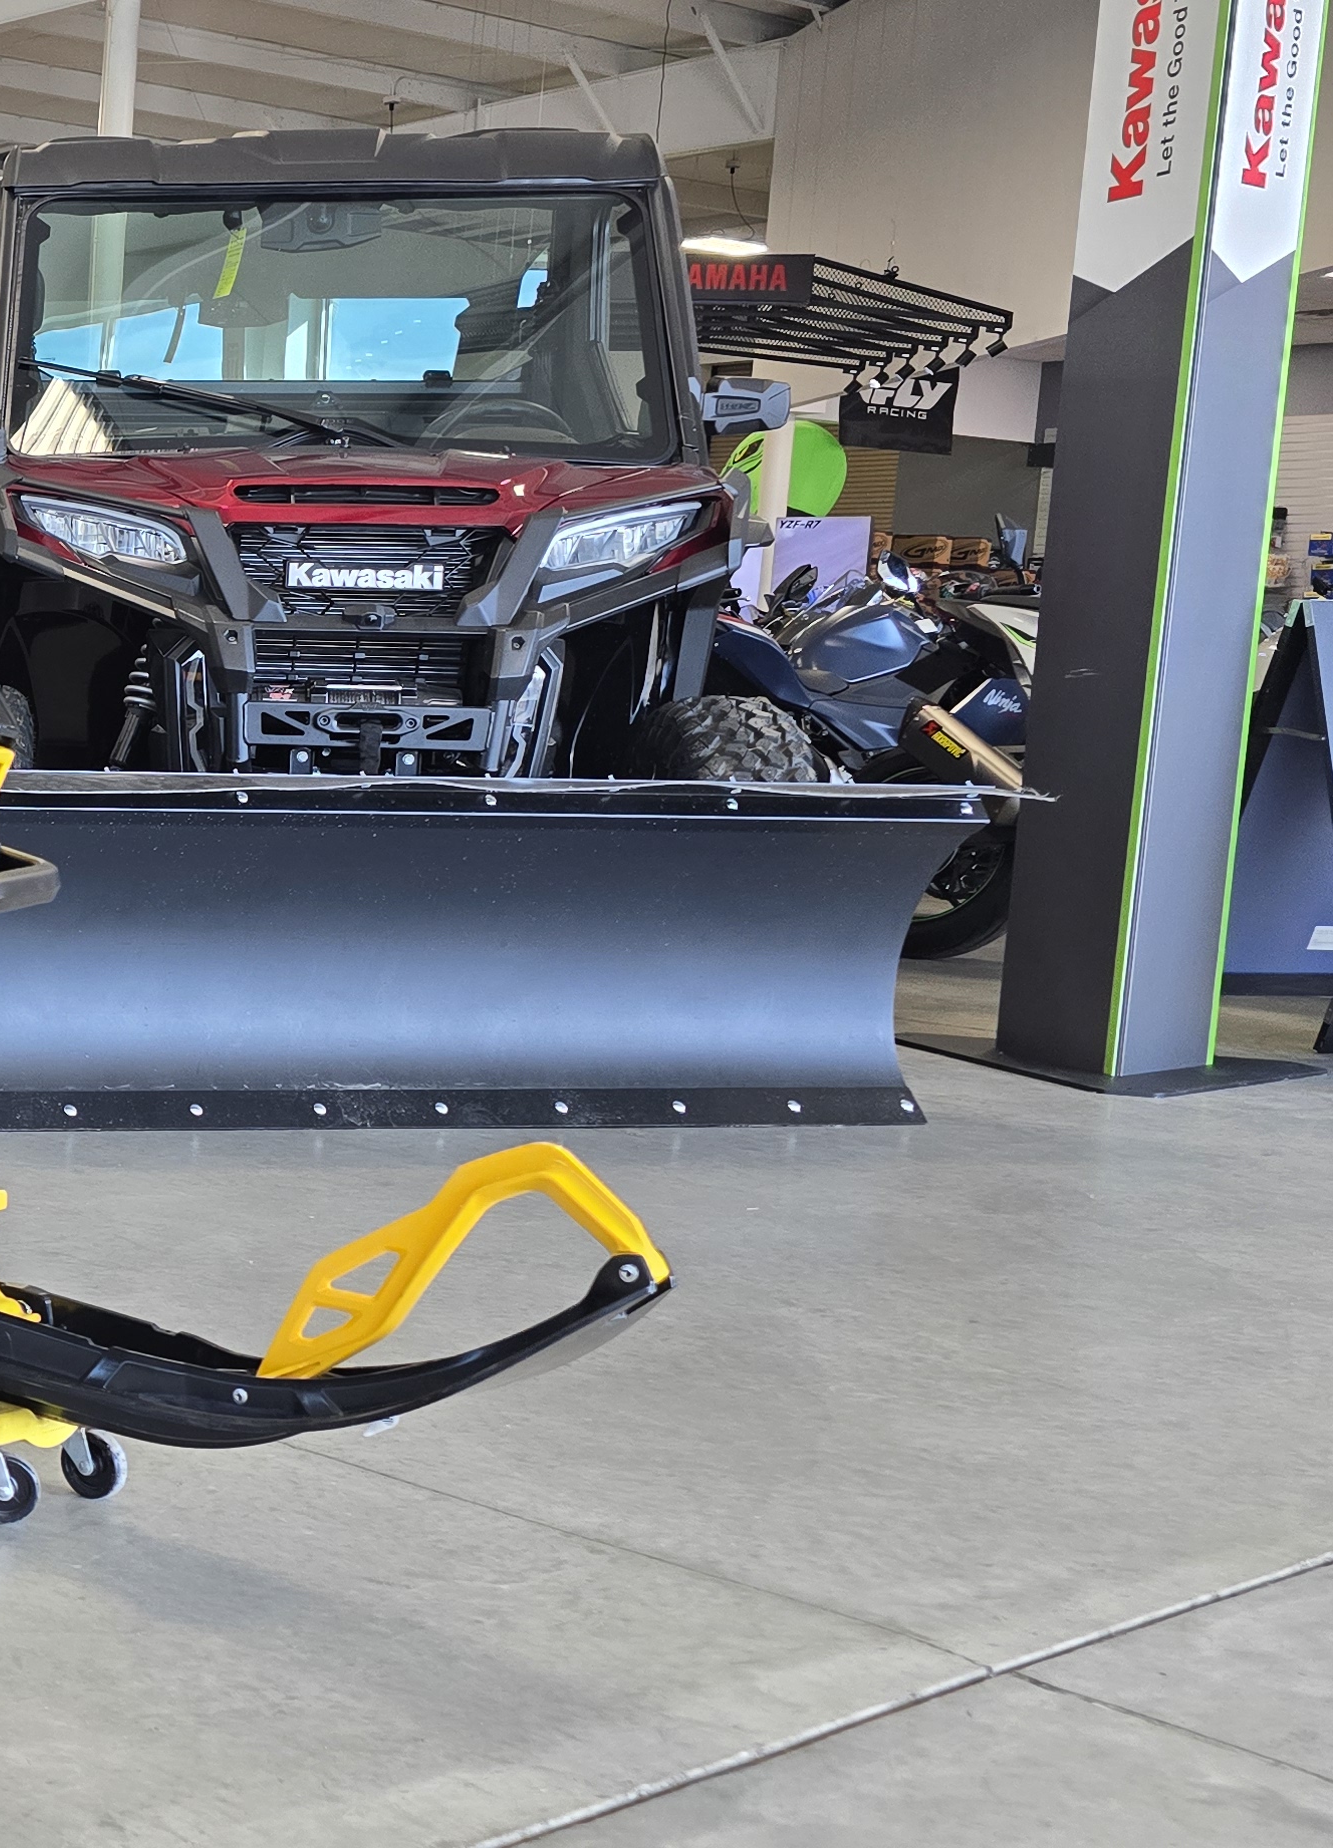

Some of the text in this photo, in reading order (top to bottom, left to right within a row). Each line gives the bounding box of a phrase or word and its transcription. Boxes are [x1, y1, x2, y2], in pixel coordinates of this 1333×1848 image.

[1107, 0, 1161, 203] Kawa
[1156, 6, 1188, 177] Let the Good
[1275, 8, 1303, 178] Let the Good
[867, 405, 928, 420] RACING
[779, 519, 822, 530] YZF-R7
[287, 562, 444, 591] Kawasaki
[982, 688, 1023, 714] Ninja
